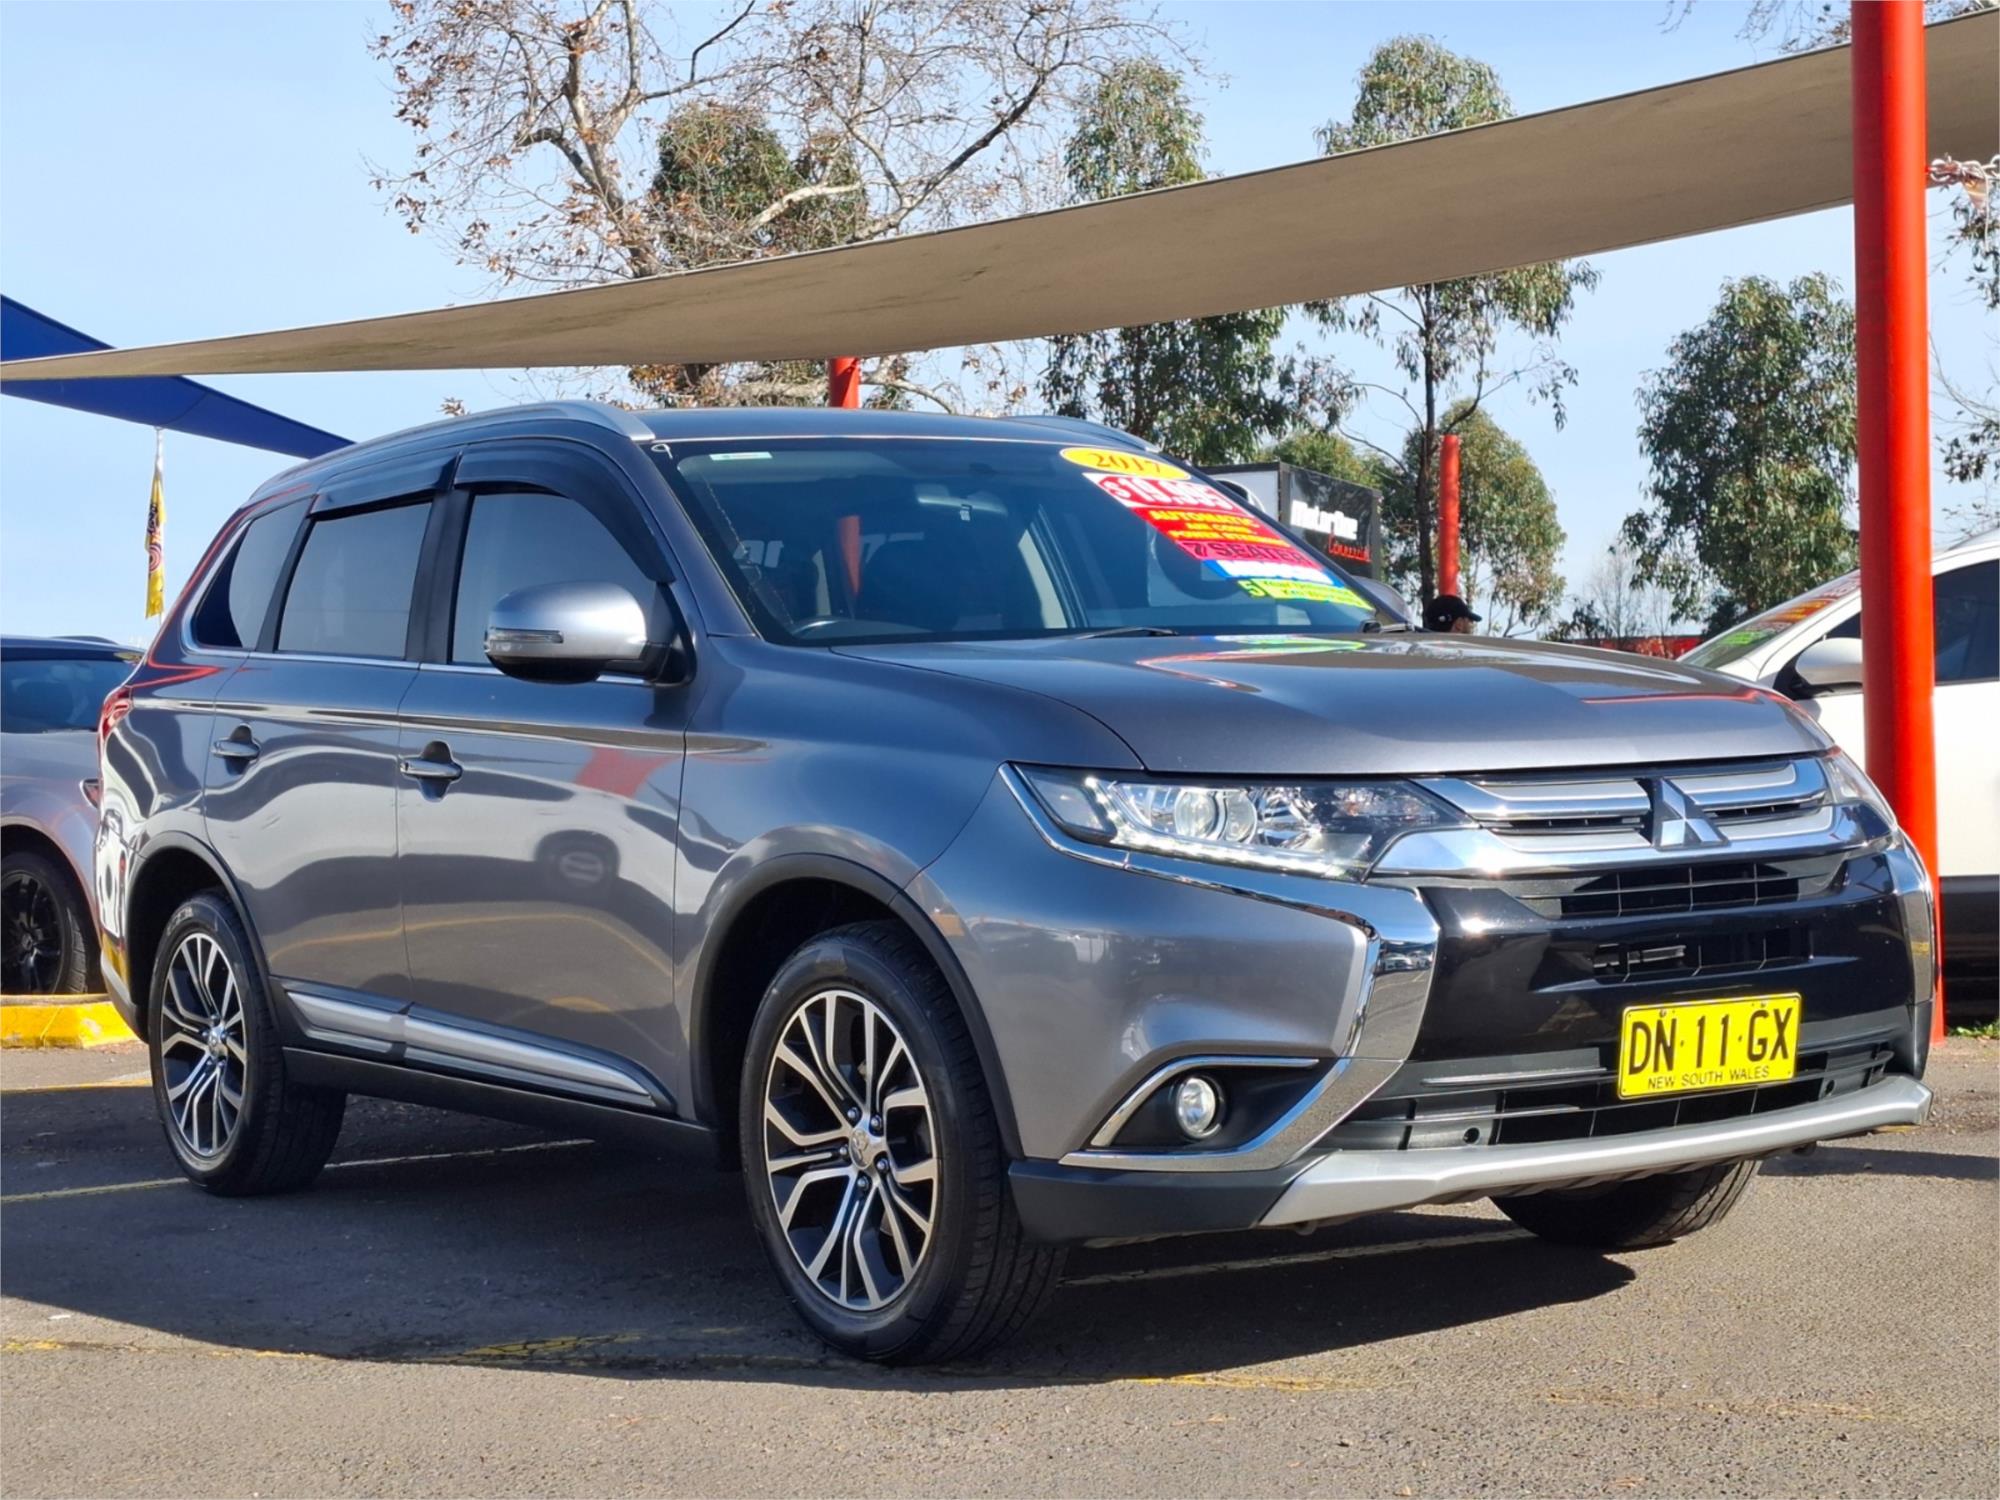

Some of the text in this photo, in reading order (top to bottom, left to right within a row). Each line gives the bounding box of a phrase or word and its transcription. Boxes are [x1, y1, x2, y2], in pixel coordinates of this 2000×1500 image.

[1090, 453, 1161, 473] 2017
[1648, 1065, 1770, 1089] NEW SOUTH WALES
